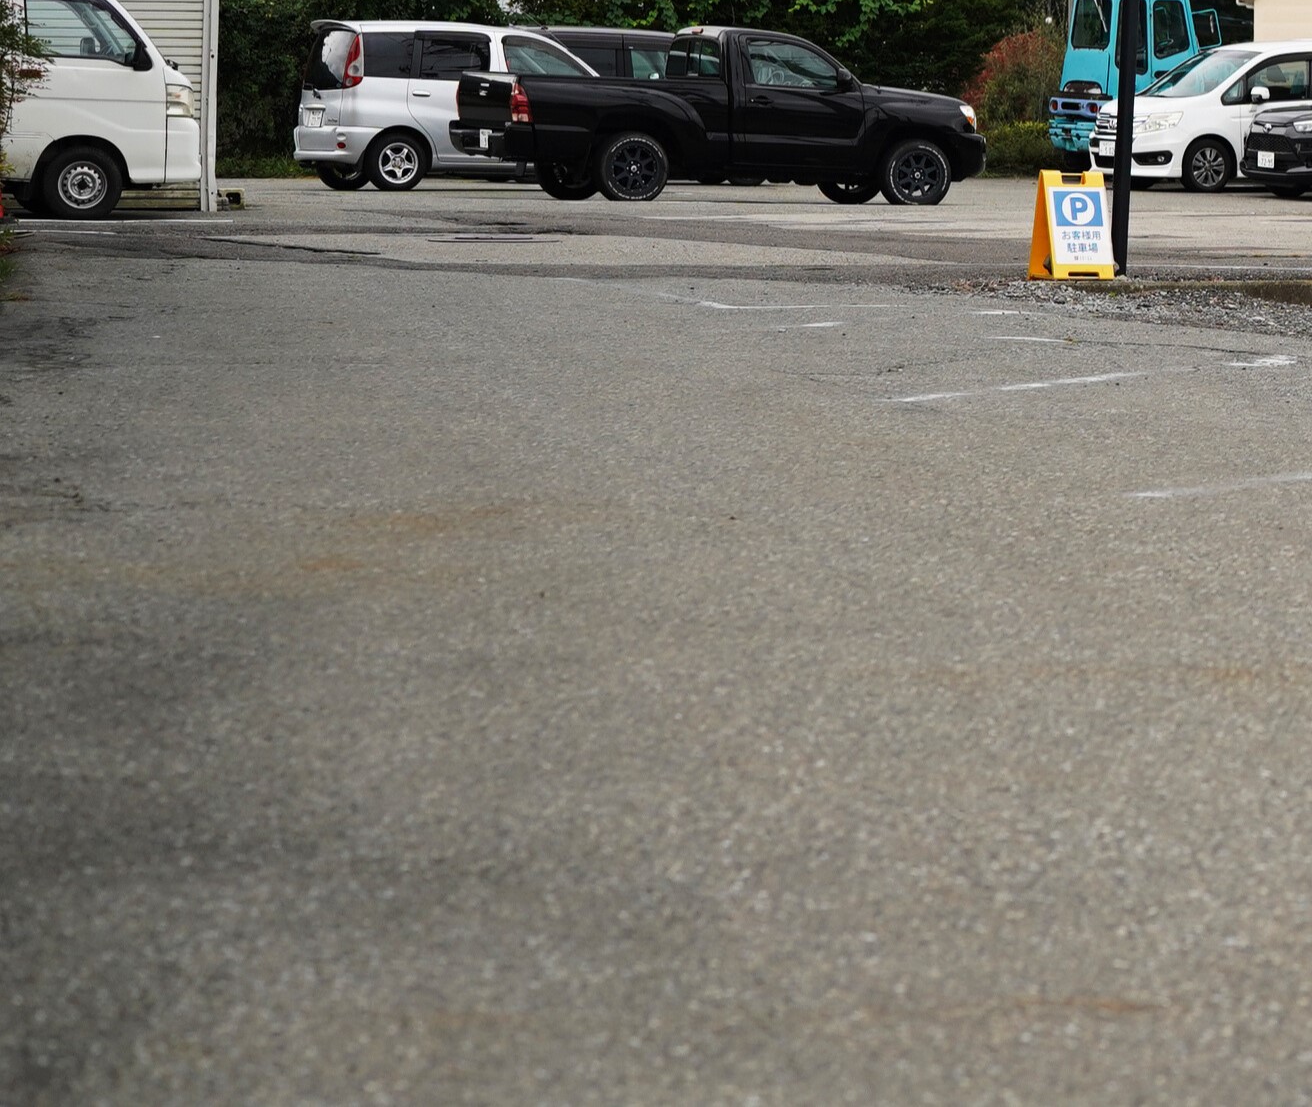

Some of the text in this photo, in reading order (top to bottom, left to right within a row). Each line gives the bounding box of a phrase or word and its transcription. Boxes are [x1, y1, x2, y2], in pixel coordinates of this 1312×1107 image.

[1070, 197, 1088, 220] P
[1061, 230, 1101, 240] お客様用
[1067, 242, 1098, 253] 駐車場
